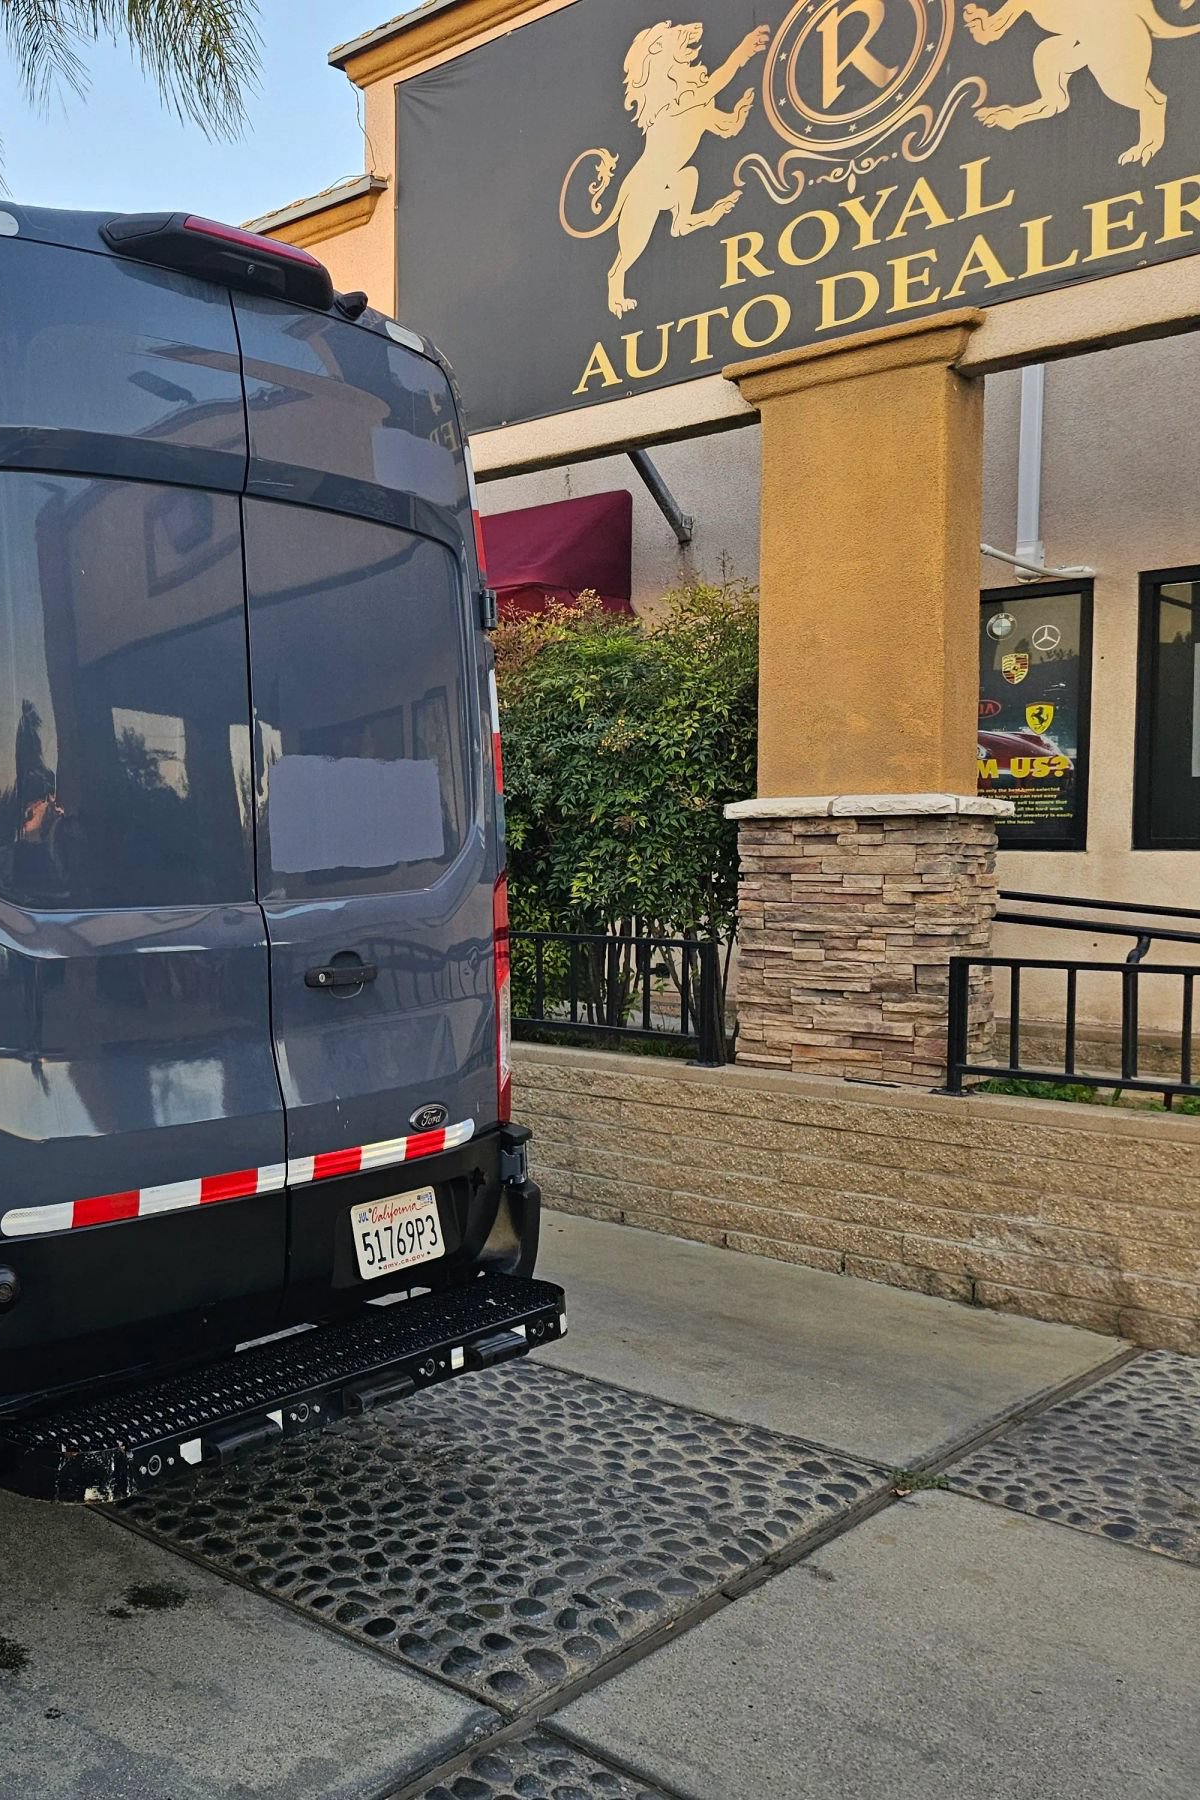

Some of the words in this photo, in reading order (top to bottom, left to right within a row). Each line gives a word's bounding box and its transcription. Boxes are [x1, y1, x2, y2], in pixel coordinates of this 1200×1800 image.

[720, 157, 1015, 288] ROYAL
[572, 295, 791, 395] AUTO
[1010, 755, 1069, 778] US?
[421, 1109, 442, 1127] Ford
[371, 1202, 421, 1224] California
[362, 1214, 438, 1266] 51769P3
[383, 1253, 426, 1270] dmv.ca.gov
